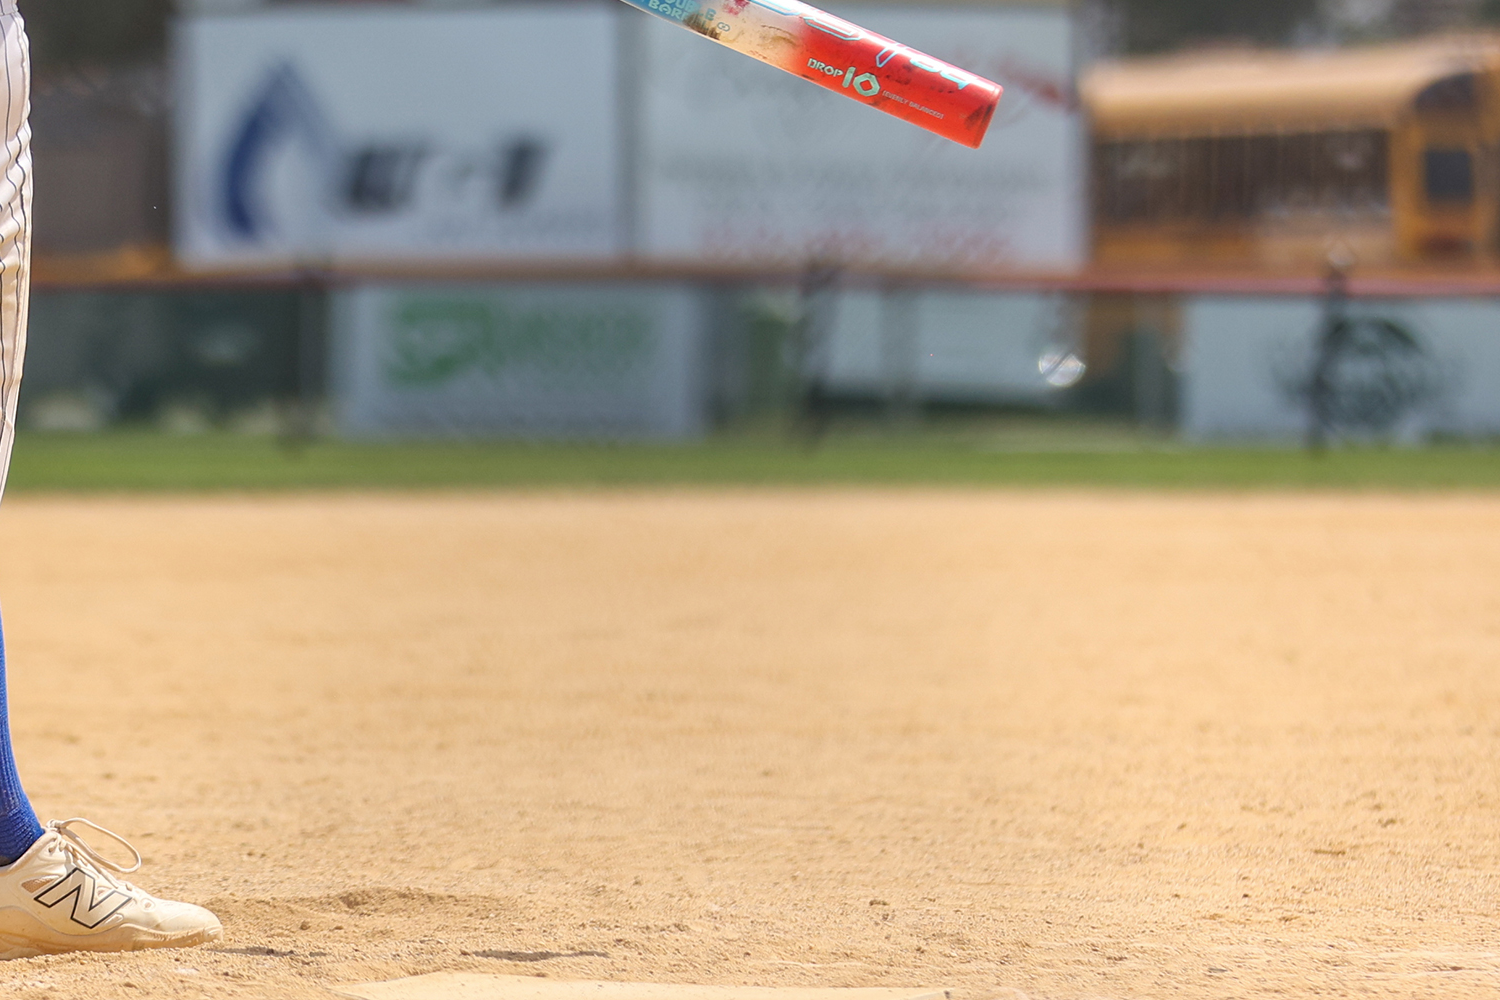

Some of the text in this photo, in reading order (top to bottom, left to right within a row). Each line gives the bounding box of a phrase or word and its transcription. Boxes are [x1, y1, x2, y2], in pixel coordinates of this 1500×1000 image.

[648, 0, 710, 33] BARRL
[807, 58, 844, 78] DROP
[842, 66, 881, 97] 10
[33, 867, 133, 930] N
